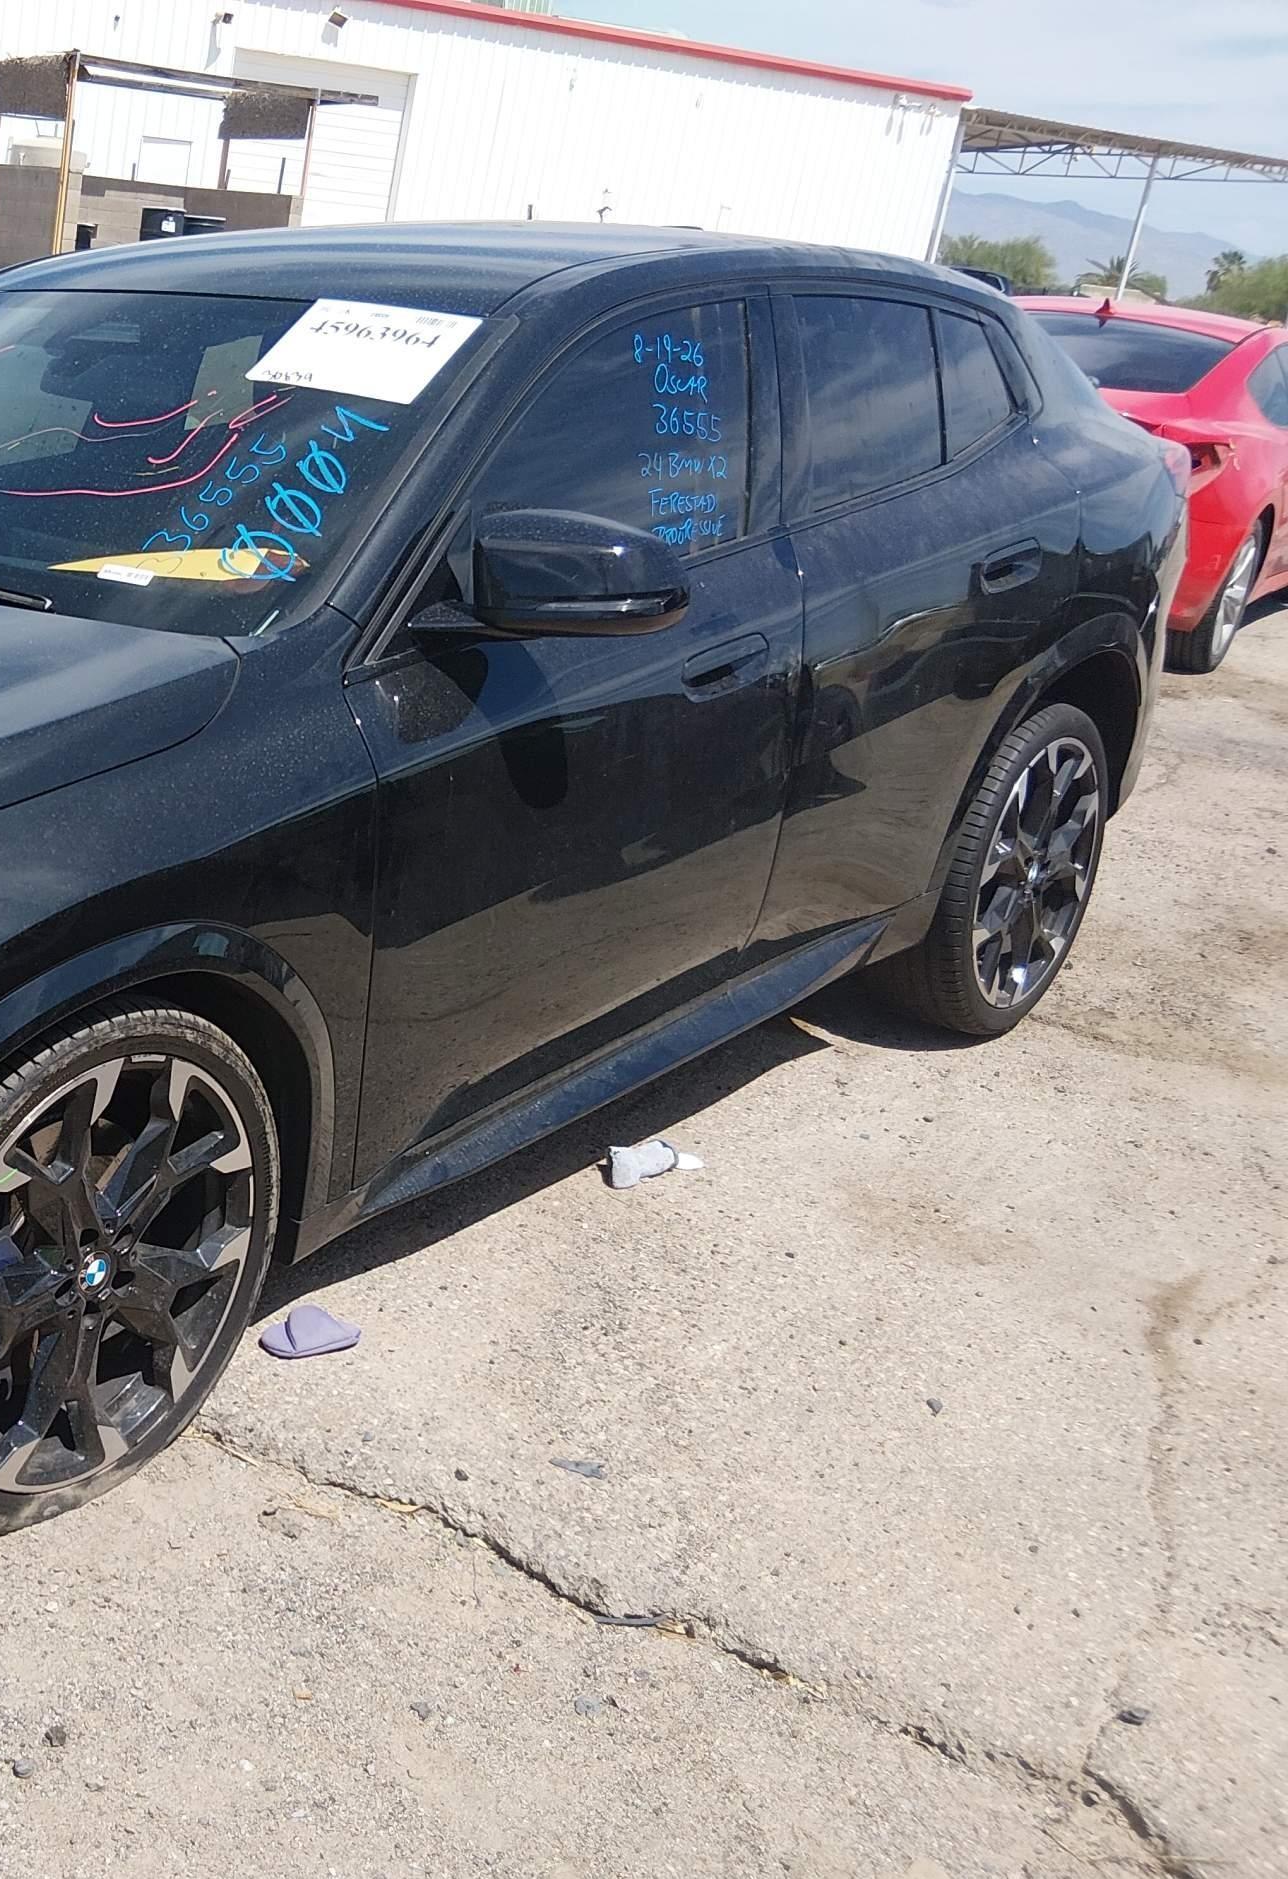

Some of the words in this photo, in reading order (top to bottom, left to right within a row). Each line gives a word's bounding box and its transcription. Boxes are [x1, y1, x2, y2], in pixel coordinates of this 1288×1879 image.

[310, 319, 442, 349] 45963964
[633, 334, 704, 367] 8-19-26
[652, 403, 722, 442] 36555
[637, 452, 662, 481] 24
[707, 454, 728, 480] X2
[142, 432, 288, 553] 36555
